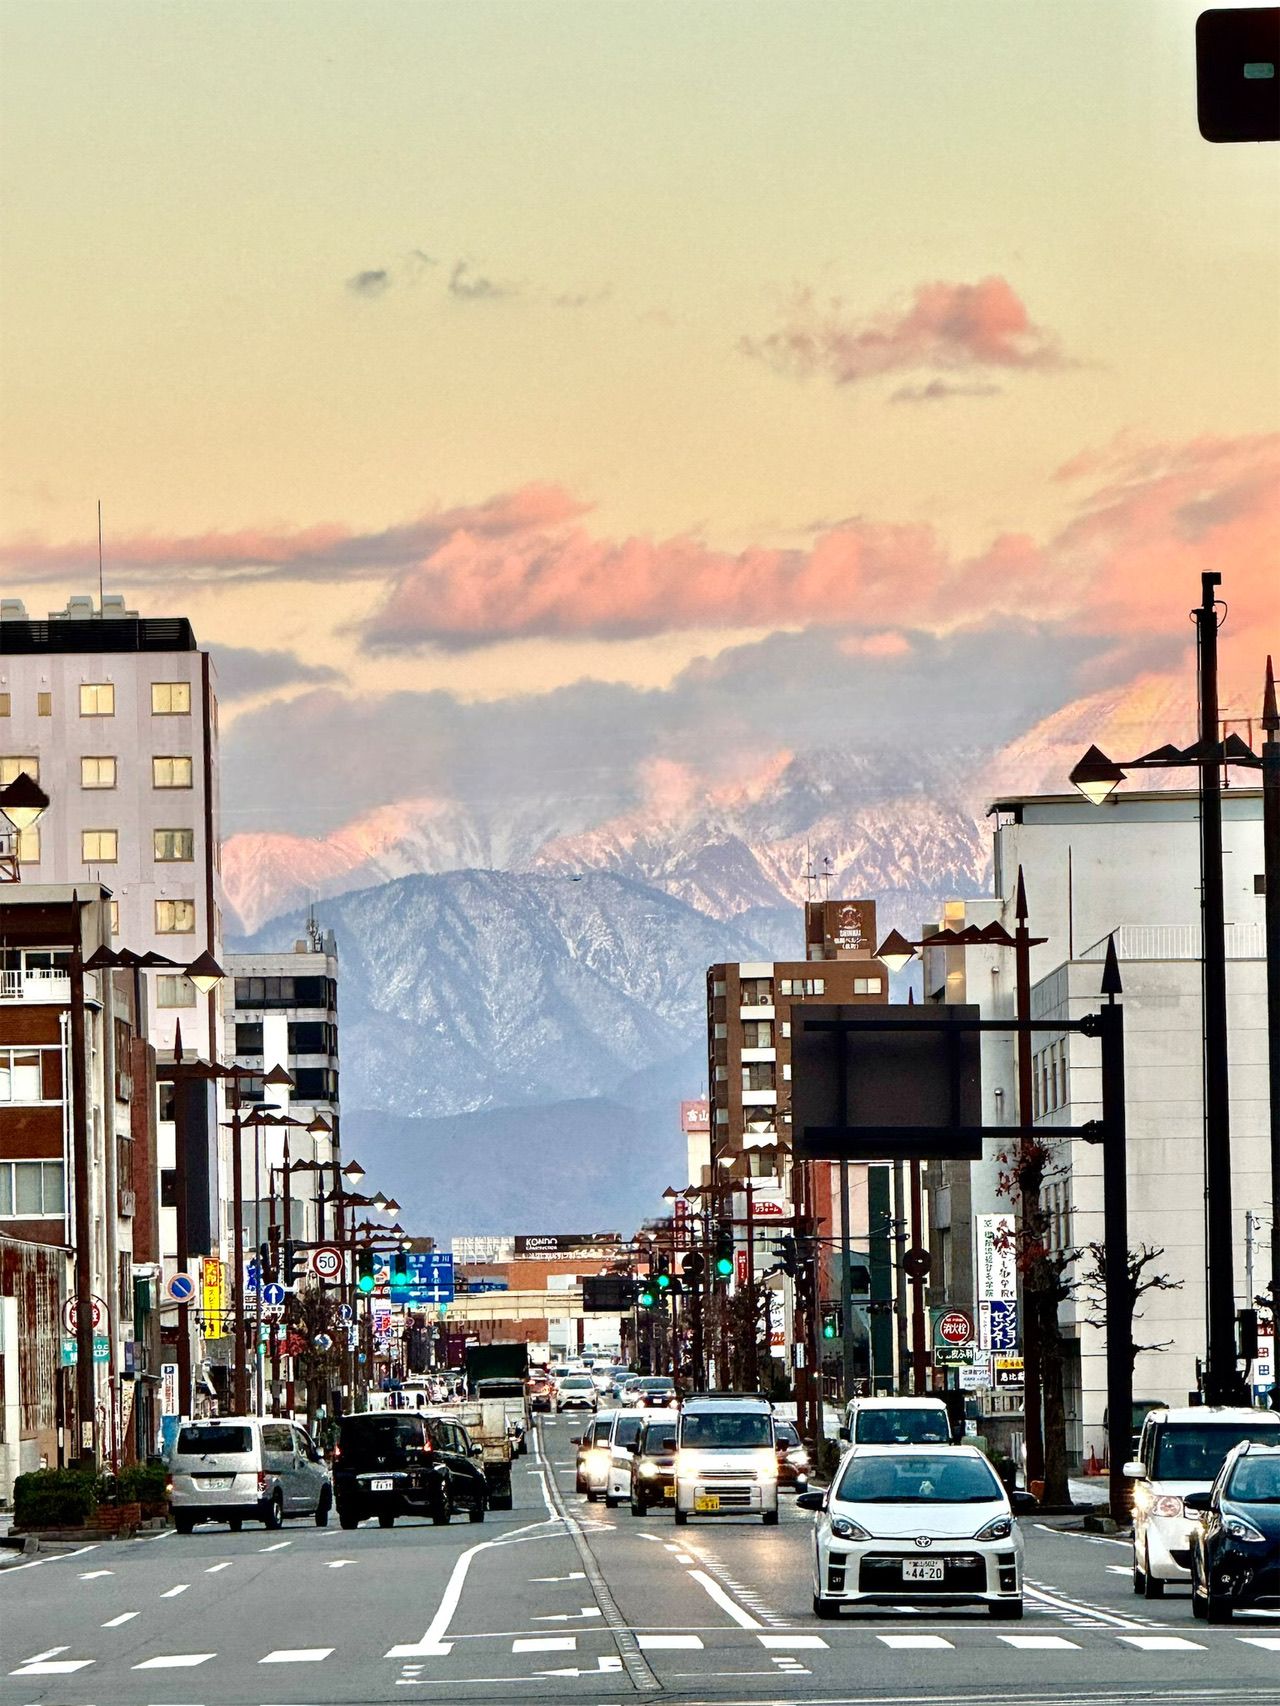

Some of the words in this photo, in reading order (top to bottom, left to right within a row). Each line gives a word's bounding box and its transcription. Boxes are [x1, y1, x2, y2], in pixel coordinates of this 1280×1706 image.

[318, 1256, 336, 1269] 50
[943, 1323, 967, 1335] 消火栓
[991, 1311, 1004, 1348] センター
[1004, 1302, 1016, 1348] マンション
[911, 1567, 942, 1579] 44-20
